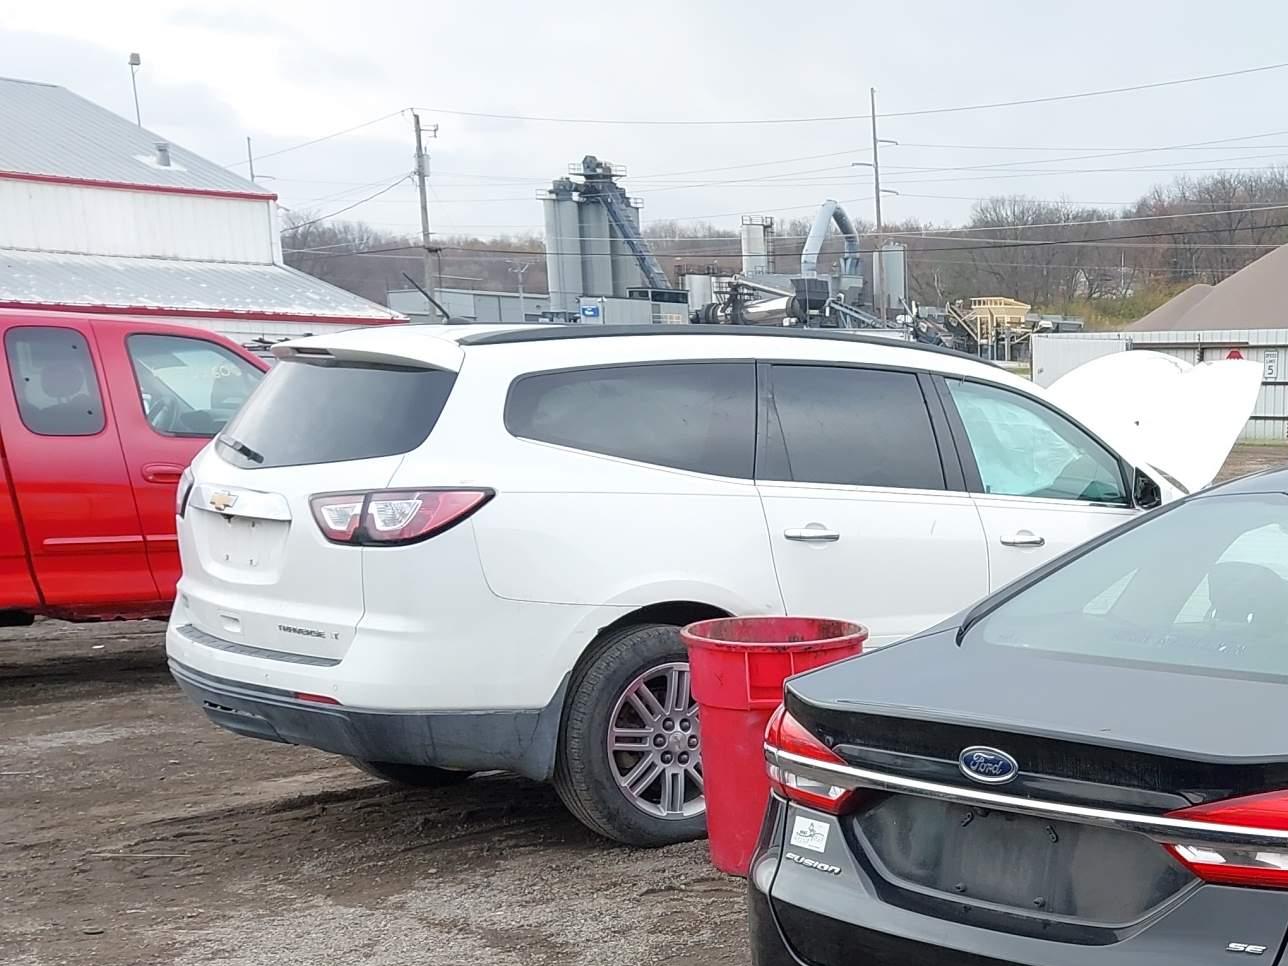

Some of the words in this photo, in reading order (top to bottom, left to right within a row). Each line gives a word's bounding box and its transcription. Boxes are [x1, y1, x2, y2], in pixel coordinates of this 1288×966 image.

[1267, 365, 1274, 375] 5
[970, 752, 1003, 775] Ford
[1226, 942, 1267, 954] SE
